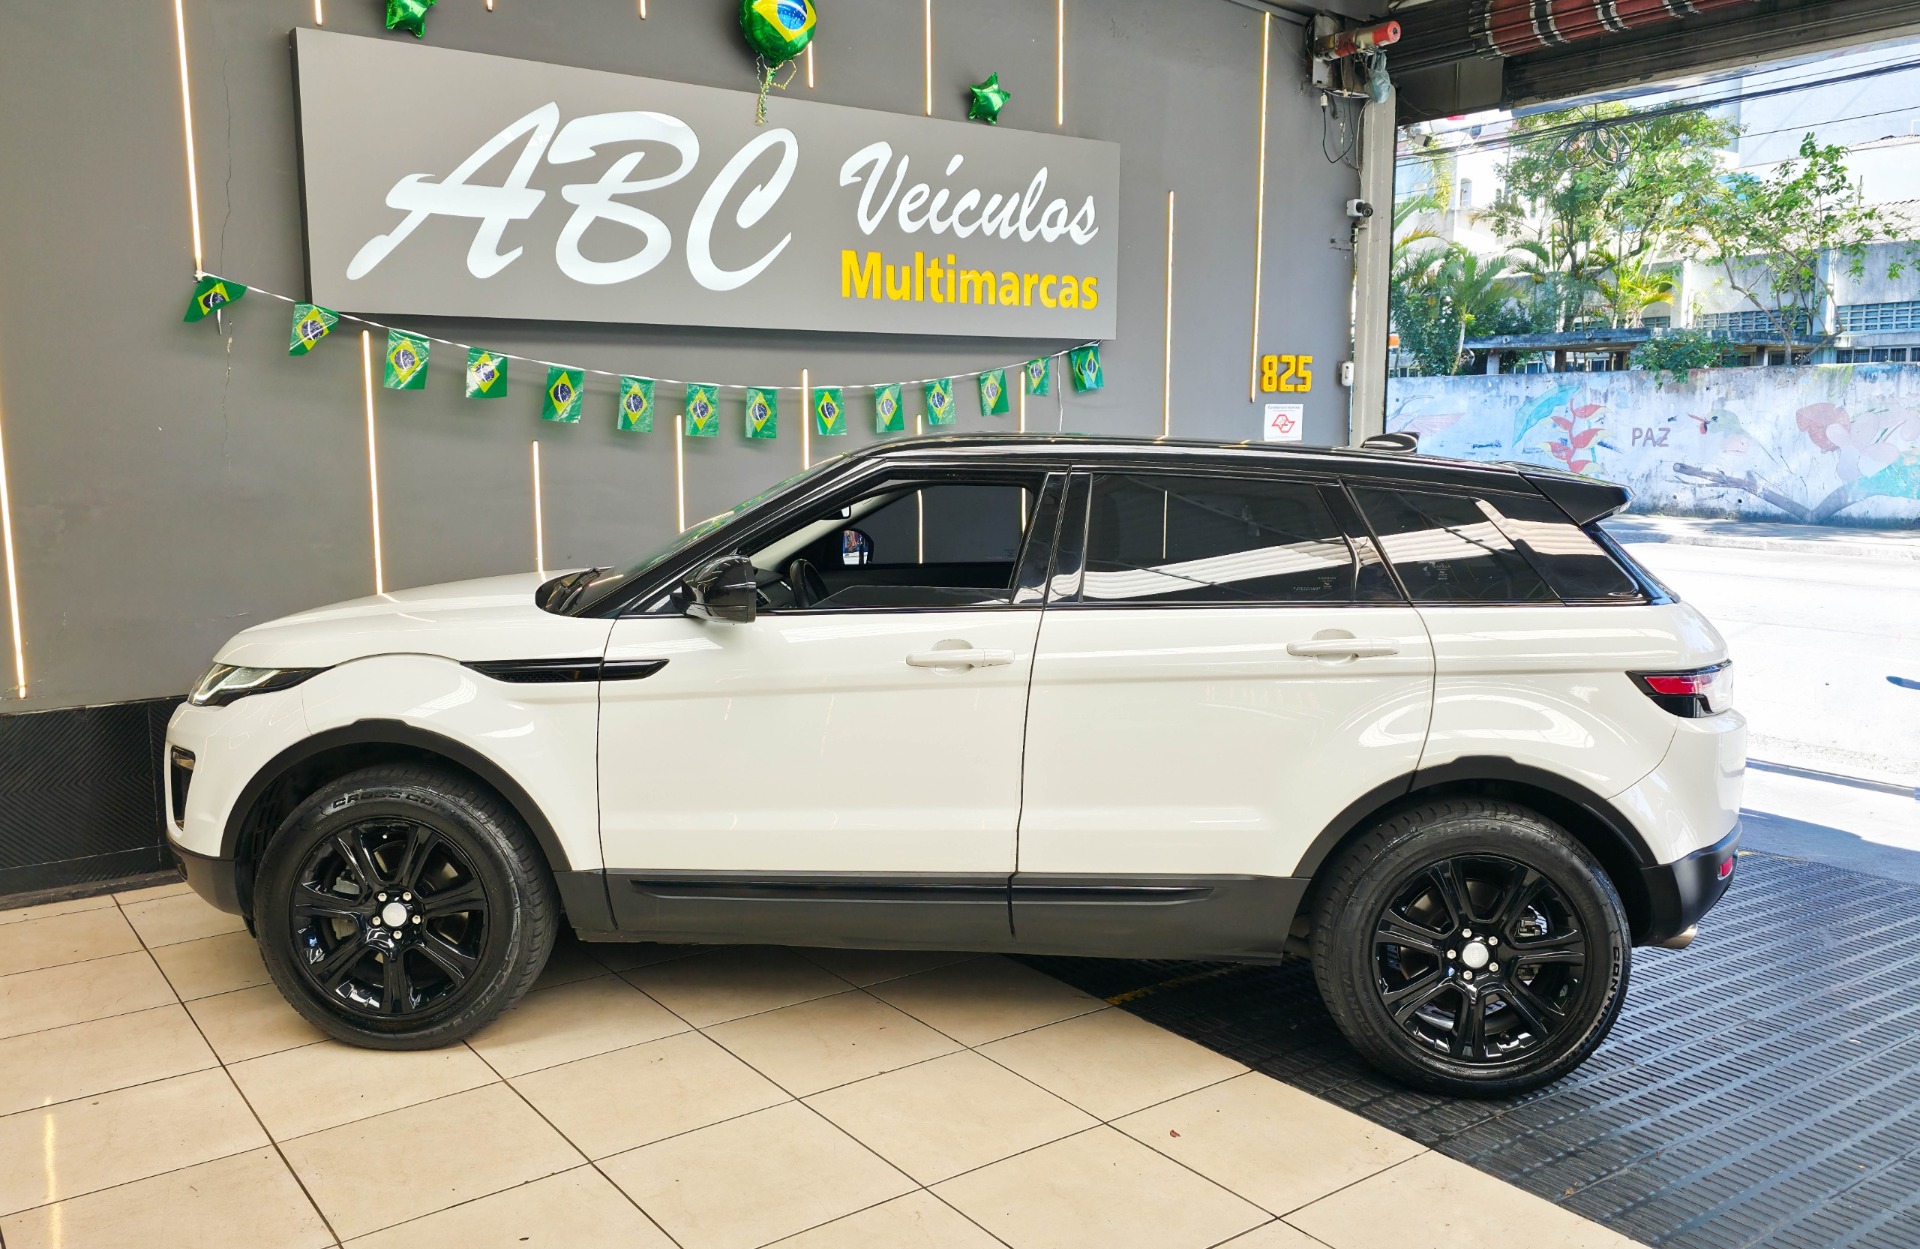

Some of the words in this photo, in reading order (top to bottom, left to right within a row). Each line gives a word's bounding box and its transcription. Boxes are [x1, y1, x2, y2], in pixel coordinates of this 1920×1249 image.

[347, 102, 799, 291] ABC
[839, 142, 1099, 246] Veículos
[840, 249, 1100, 311] Multimarcas
[1260, 354, 1313, 393] 825
[1631, 427, 1671, 447] PAZ
